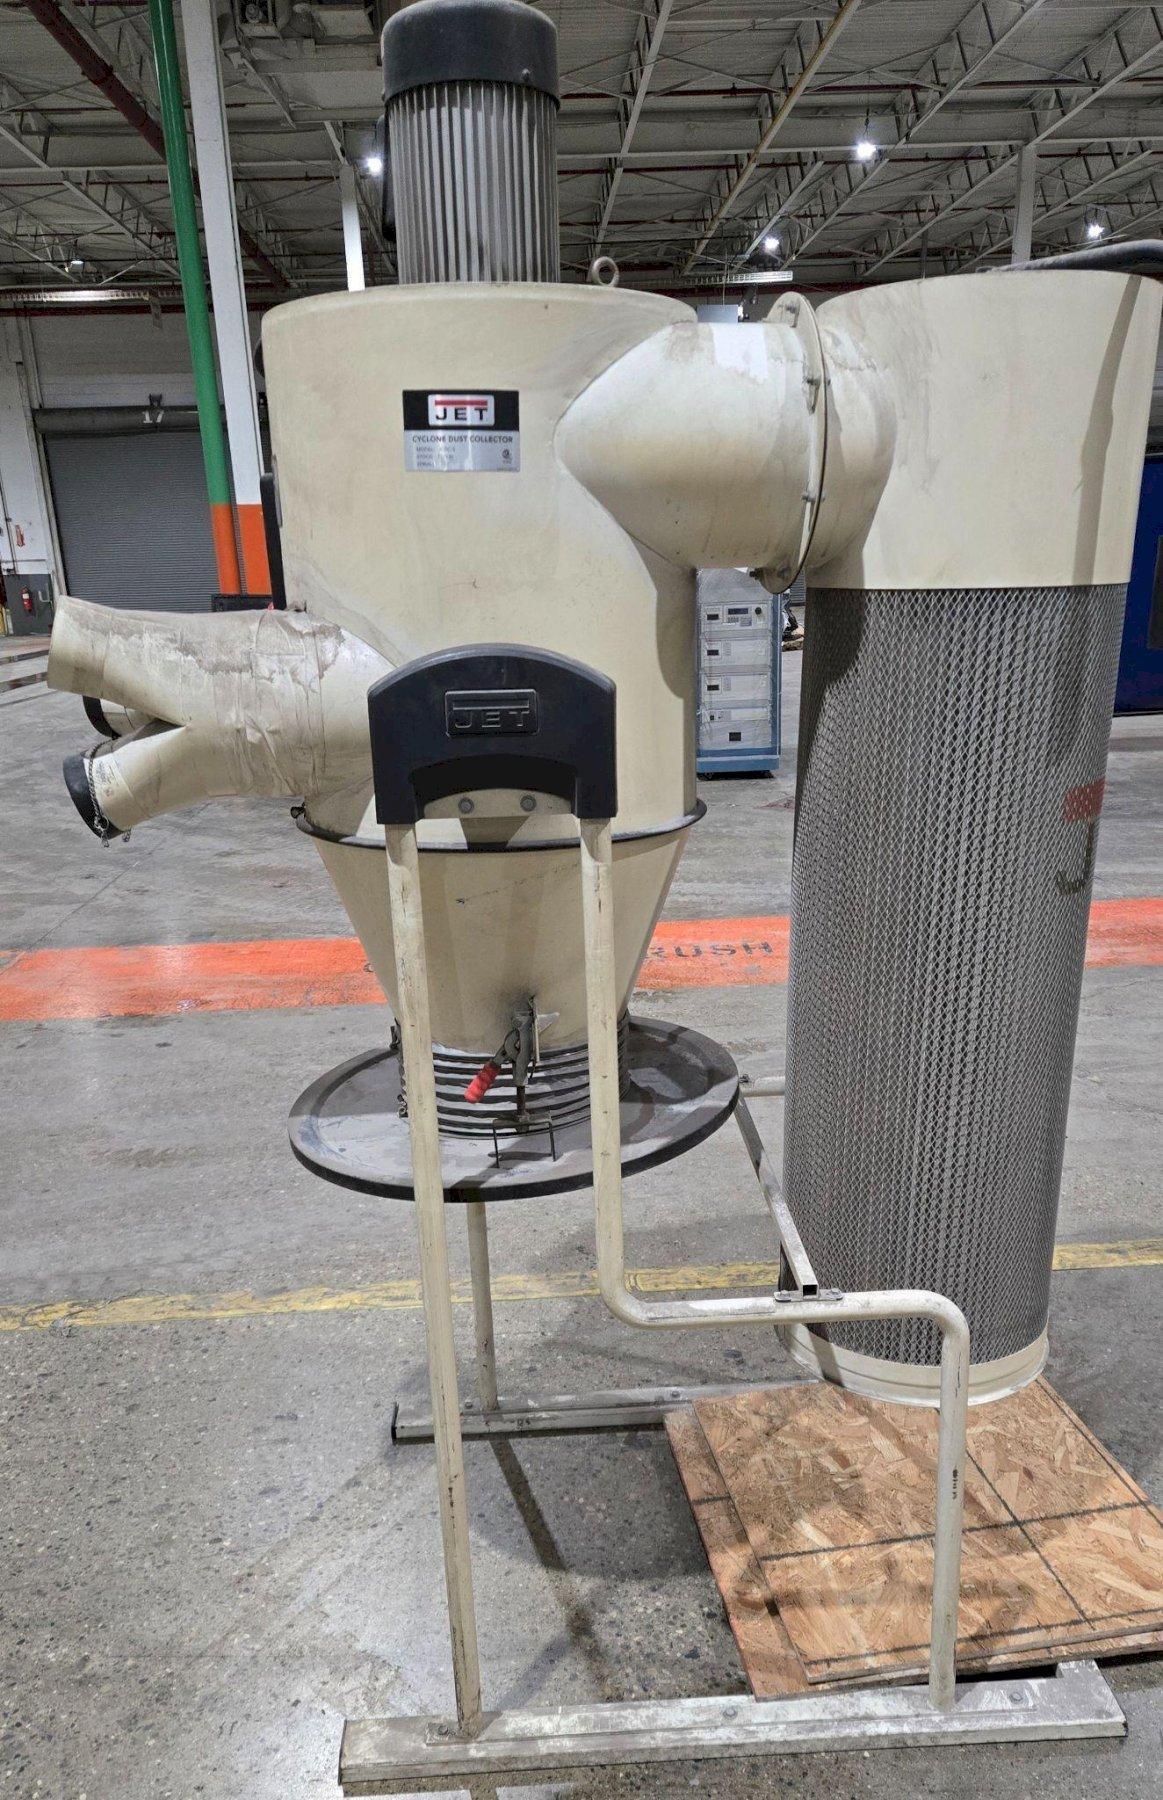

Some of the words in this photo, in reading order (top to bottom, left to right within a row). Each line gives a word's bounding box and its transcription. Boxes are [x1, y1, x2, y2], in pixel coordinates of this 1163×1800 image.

[142, 409, 165, 424] 17
[435, 407, 488, 421] JET
[412, 434, 446, 443] CYCLONE
[448, 434, 468, 443] DUST
[469, 435, 513, 444] COLLECTOR
[453, 710, 530, 729] JET
